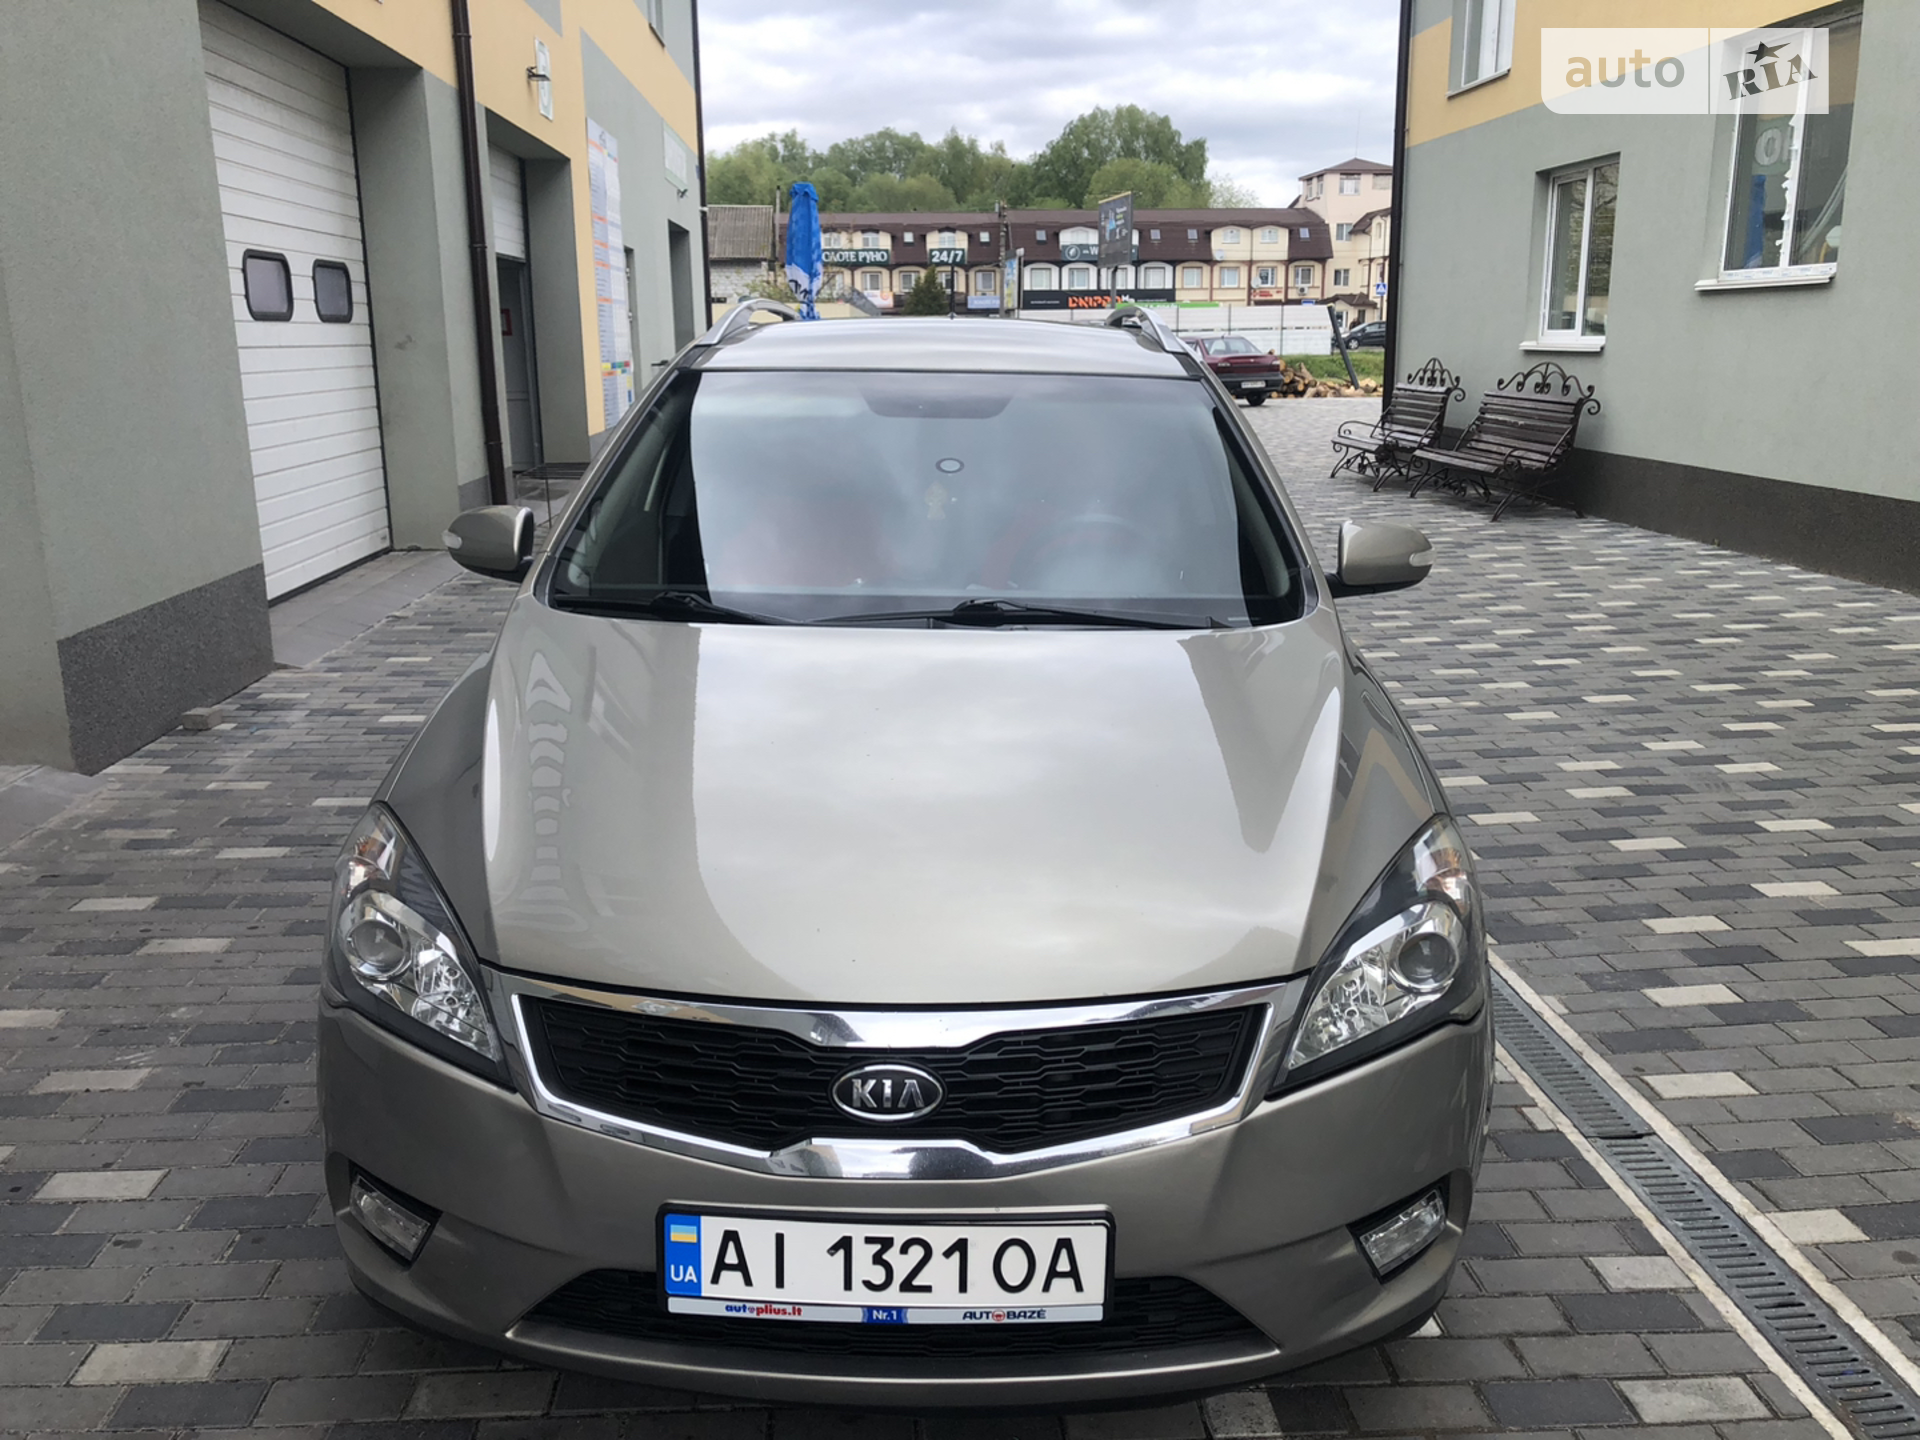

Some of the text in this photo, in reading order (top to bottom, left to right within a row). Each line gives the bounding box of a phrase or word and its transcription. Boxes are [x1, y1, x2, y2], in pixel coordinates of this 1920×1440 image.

[822, 251, 857, 262] ОЛОТЕ
[931, 250, 963, 263] 24/7
[851, 1078, 924, 1108] KIA
[710, 1229, 1085, 1294] AI 1321 OA
[670, 1264, 698, 1284] UA
[725, 1303, 803, 1316] autoplius.lt
